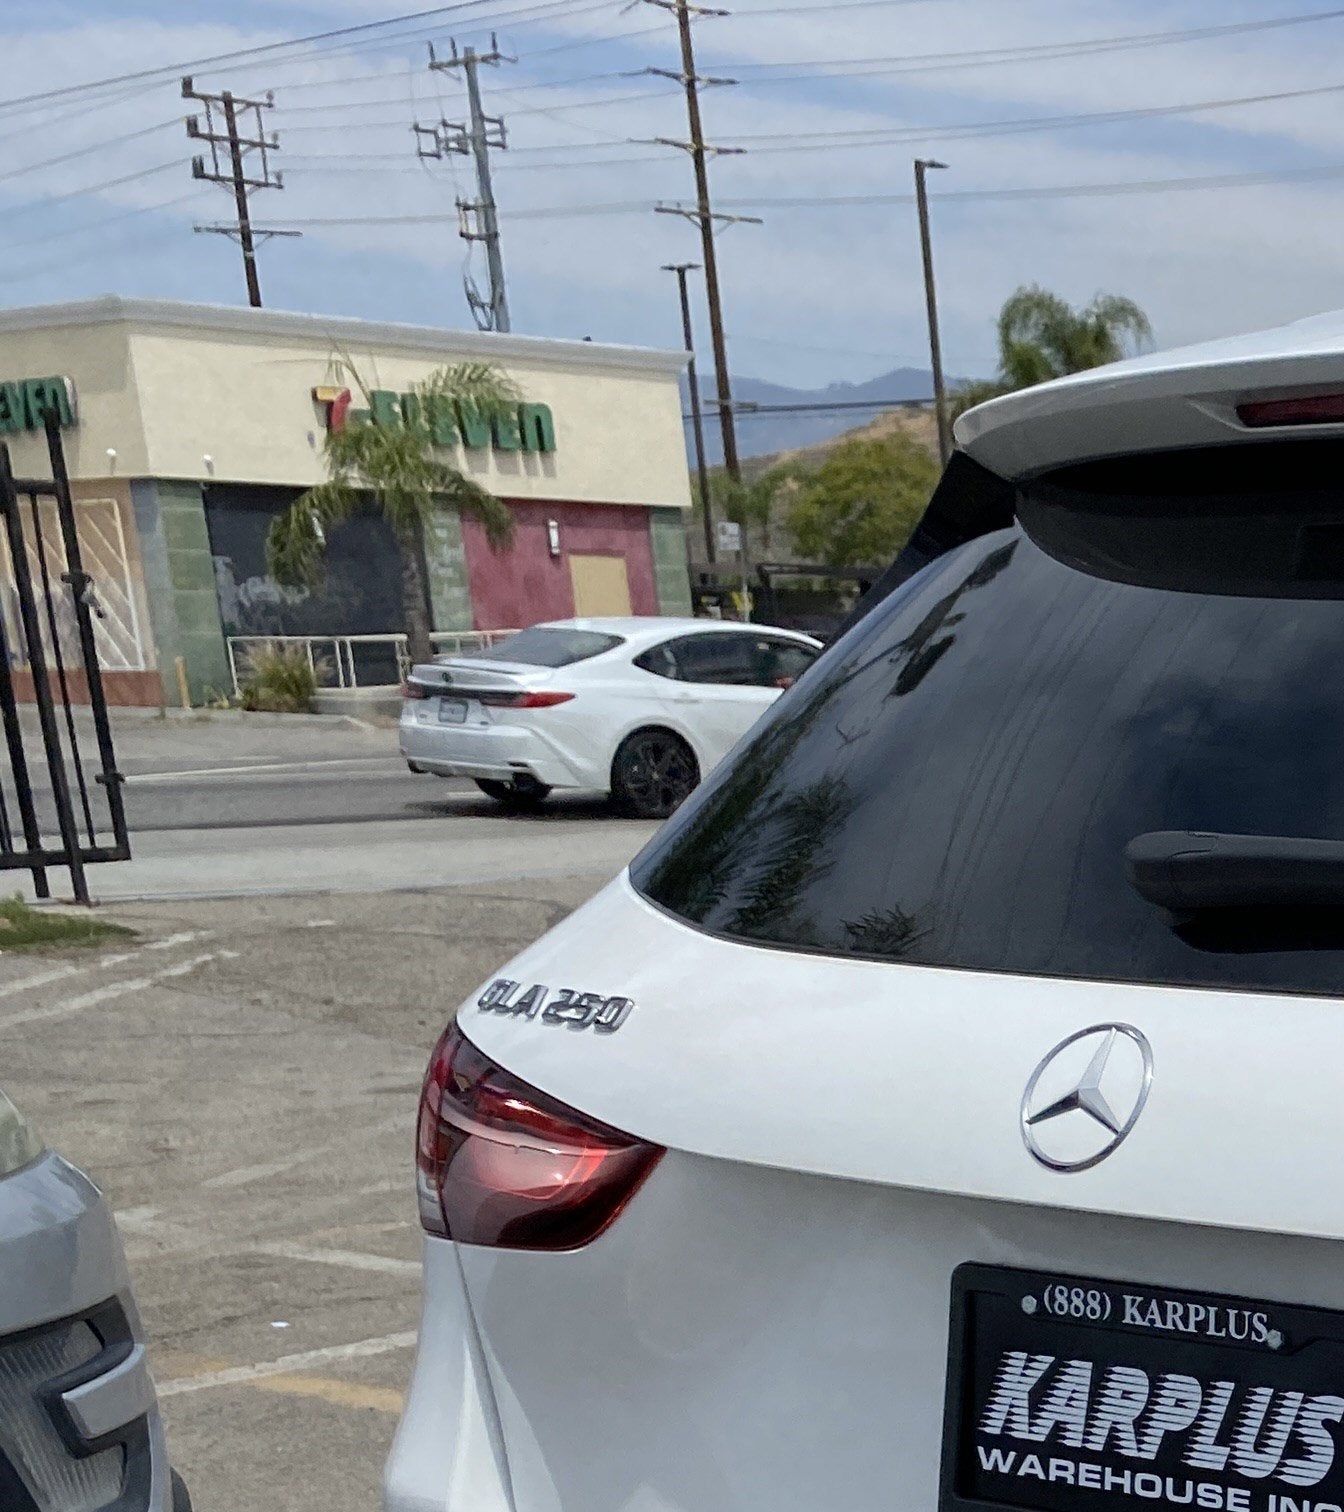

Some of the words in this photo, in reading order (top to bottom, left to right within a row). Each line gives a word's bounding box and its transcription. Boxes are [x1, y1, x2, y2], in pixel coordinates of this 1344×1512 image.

[478, 978, 549, 1020] GLA
[542, 988, 636, 1034] 250
[1043, 1284, 1111, 1321] (888)
[1121, 1294, 1269, 1343] KARPLUS
